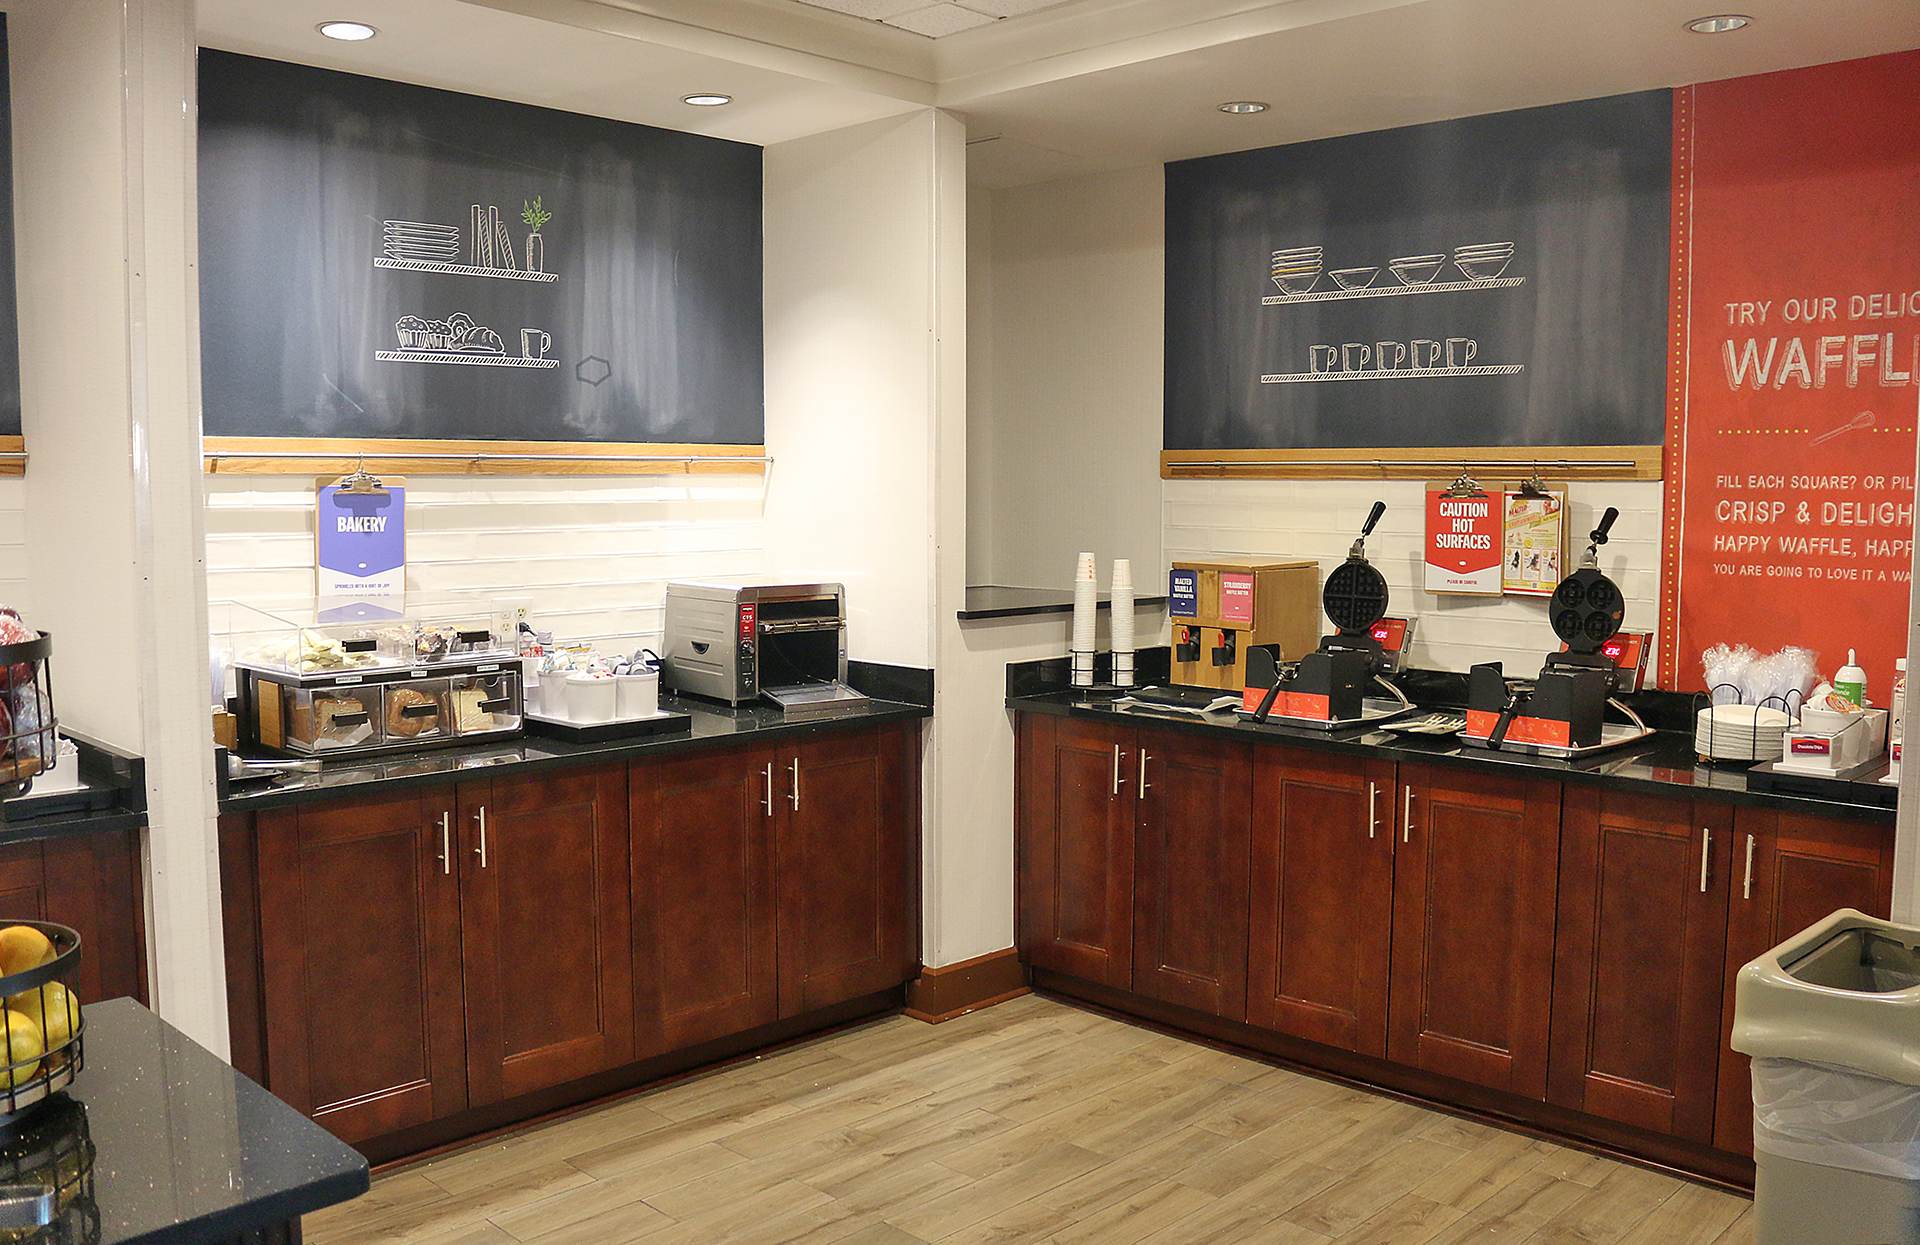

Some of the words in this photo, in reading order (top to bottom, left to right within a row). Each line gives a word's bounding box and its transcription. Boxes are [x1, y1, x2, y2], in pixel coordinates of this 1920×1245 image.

[1724, 300, 1772, 326] TRY
[1783, 297, 1838, 324] OUR
[1722, 332, 1920, 390] WAFFL
[1716, 475, 1742, 489] FILL
[1748, 475, 1785, 489] EACH
[1790, 475, 1857, 490] SQUARE?
[1863, 475, 1885, 490] OR
[1892, 475, 1914, 490] PIL
[1439, 502, 1488, 517] CAUTION
[1716, 500, 1786, 524] CRISP
[1796, 501, 1811, 525] &
[1822, 501, 1913, 526] DELIGH
[337, 516, 388, 533] BAKERY
[1452, 518, 1475, 533] HOT
[1436, 533, 1491, 550] SURFACES
[1714, 535, 1771, 553] HAPPY
[1779, 536, 1857, 558] WAFFLE,
[1714, 563, 1735, 575] YOU
[1739, 565, 1762, 576] ARE
[1766, 565, 1803, 577] GOING
[1807, 567, 1823, 578] TO
[1827, 568, 1858, 580] LOVE
[1861, 570, 1873, 581] IT
[1877, 571, 1887, 581] A
